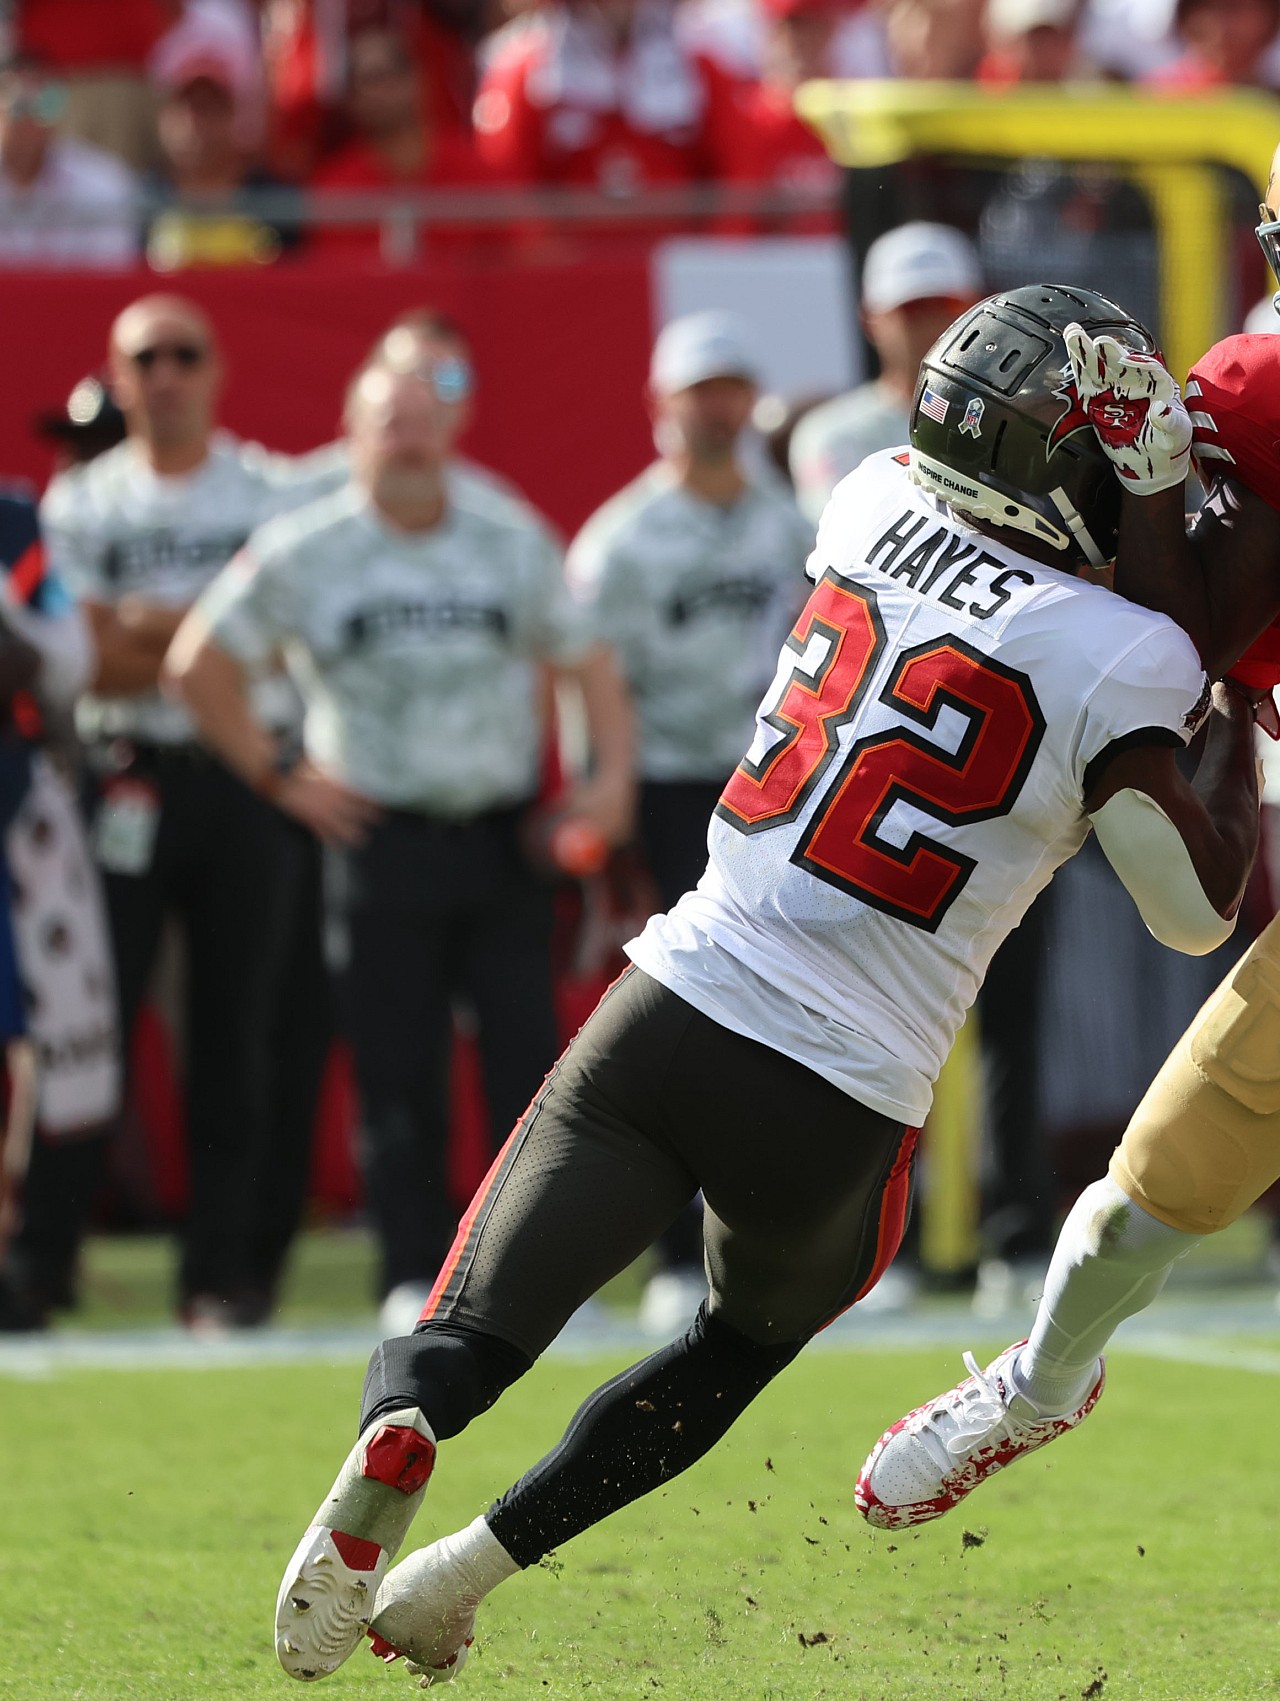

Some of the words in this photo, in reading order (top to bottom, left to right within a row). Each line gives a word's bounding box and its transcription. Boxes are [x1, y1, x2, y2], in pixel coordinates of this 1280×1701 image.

[918, 461, 943, 484] NSPIRE
[943, 477, 979, 499] CHANGE
[864, 509, 1035, 620] HAYES
[713, 565, 1047, 934] 32
